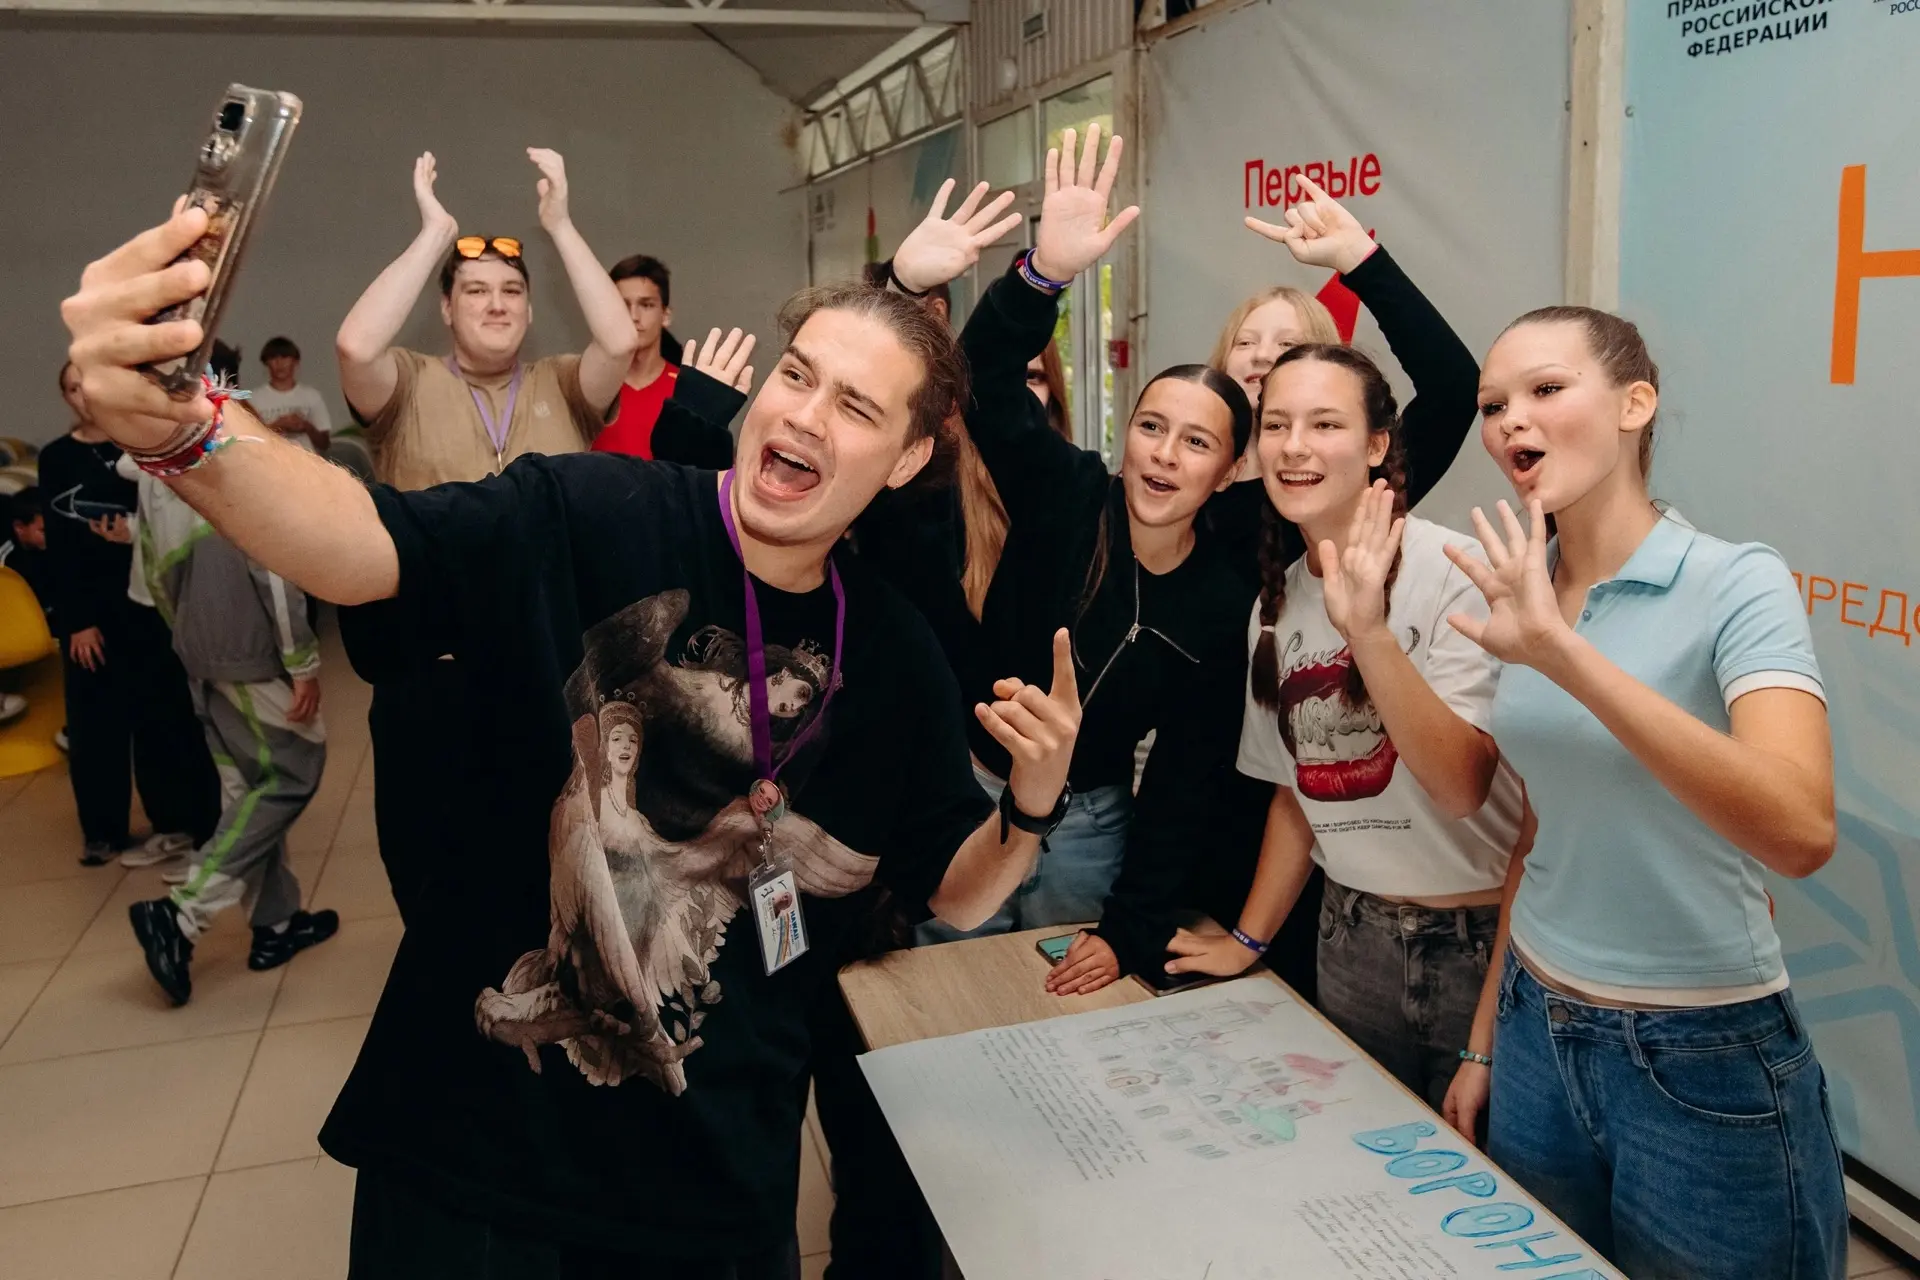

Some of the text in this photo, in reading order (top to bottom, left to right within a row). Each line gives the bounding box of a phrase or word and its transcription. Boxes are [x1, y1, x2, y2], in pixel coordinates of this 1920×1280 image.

[1687, 11, 1828, 58] ФЕДЕРАЦИИ
[1245, 153, 1381, 213] Первые
[790, 910, 800, 941] HAWAII
